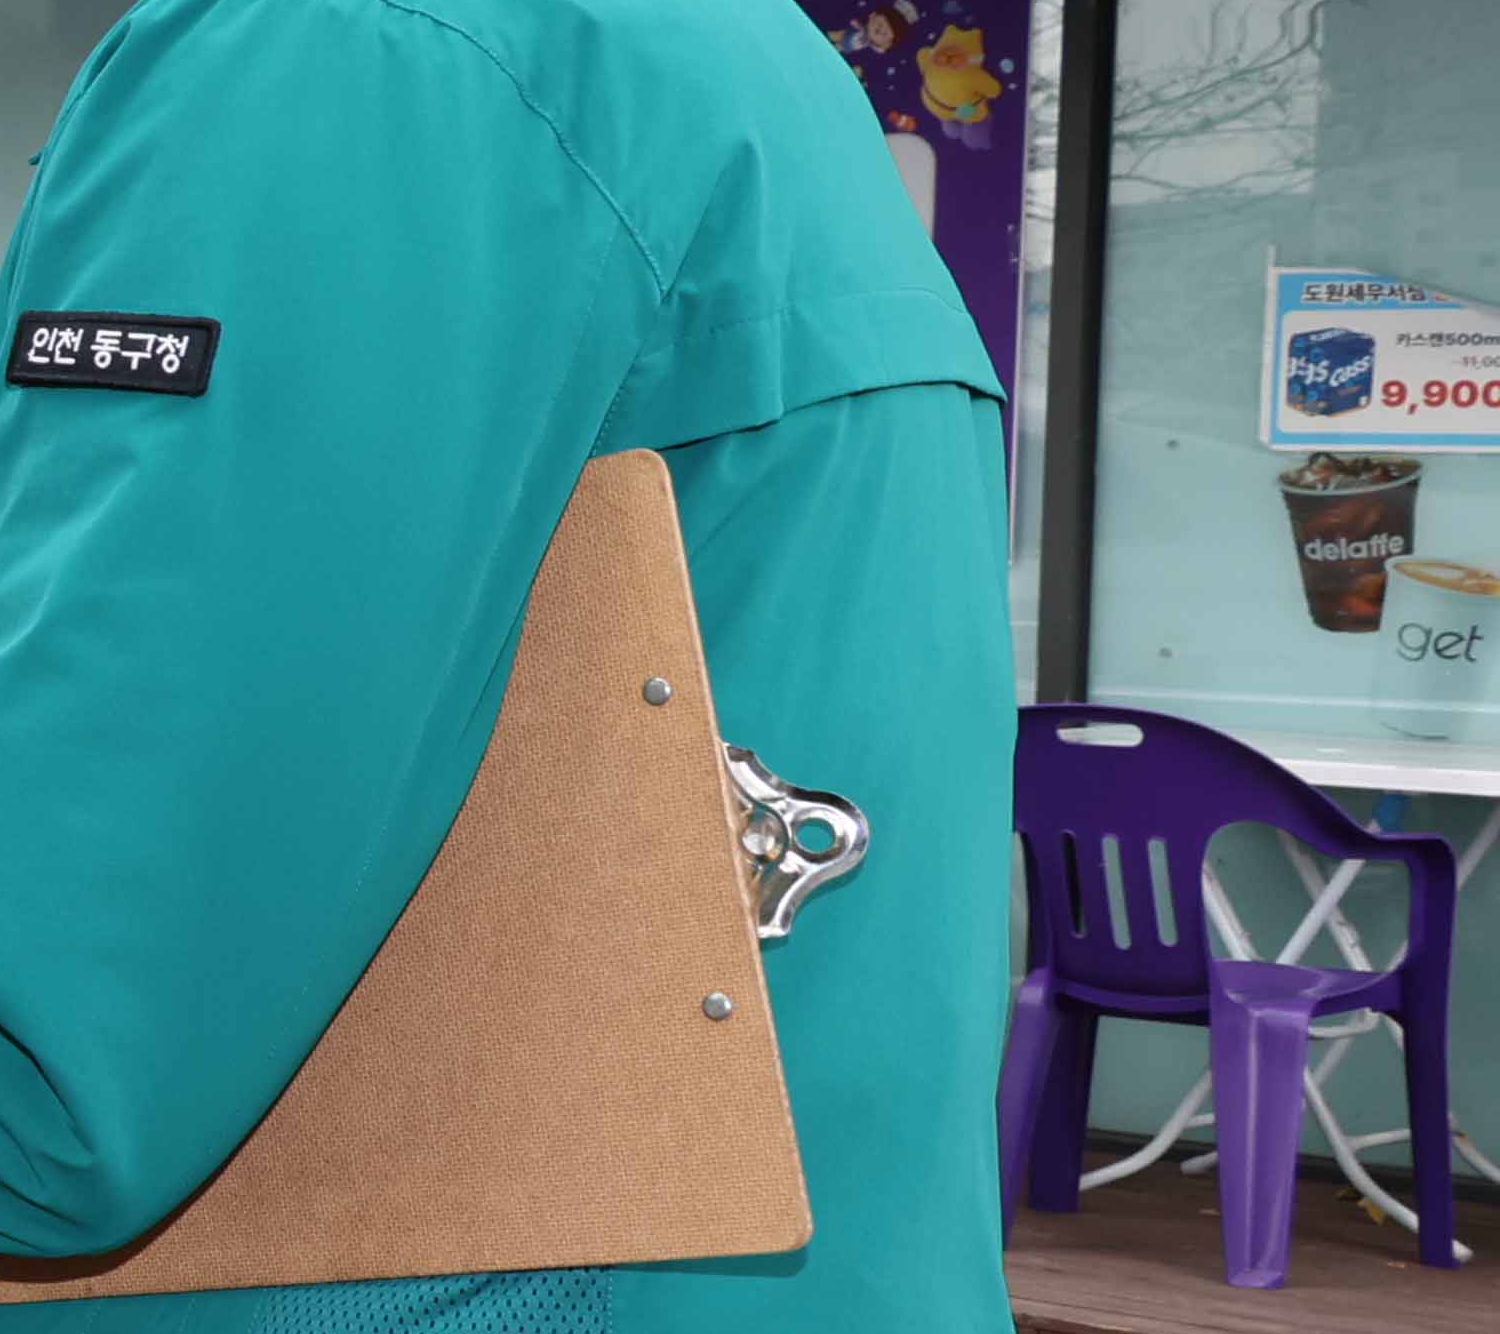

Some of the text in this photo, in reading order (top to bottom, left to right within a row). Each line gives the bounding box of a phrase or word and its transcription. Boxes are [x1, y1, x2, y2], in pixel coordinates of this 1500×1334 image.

[28, 326, 188, 373] 인천 동구청
[1304, 533, 1404, 561] delaffe
[1397, 622, 1483, 661] get
